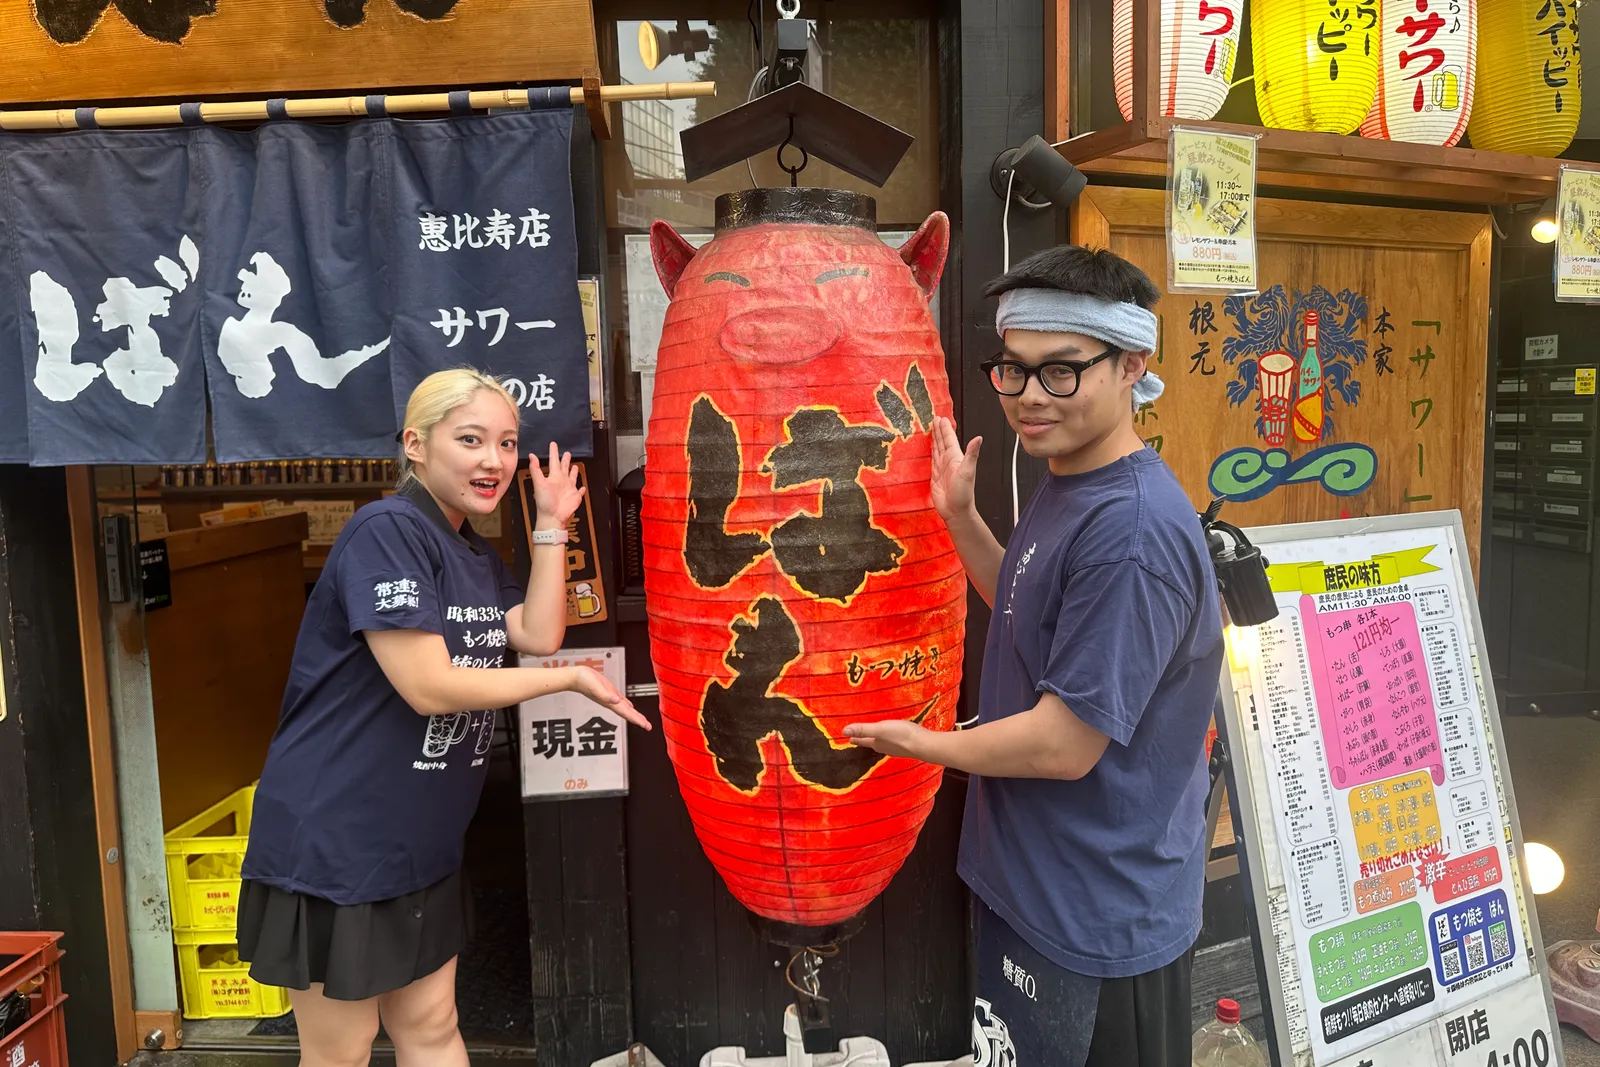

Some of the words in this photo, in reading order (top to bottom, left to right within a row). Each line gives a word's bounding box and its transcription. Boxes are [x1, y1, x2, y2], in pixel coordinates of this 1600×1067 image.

[1317, 0, 1352, 81] ッピー
[1356, 0, 1377, 56] ワー
[1396, 0, 1446, 112] サワー
[1193, 246, 1222, 260] 880円
[430, 306, 556, 347] サワー
[1323, 561, 1381, 591] 庶民の味方
[1326, 620, 1352, 638] もつ串
[1353, 616, 1400, 652] 121円均一
[532, 716, 618, 759] 現金
[564, 778, 588, 790] のみ
[1452, 906, 1484, 931] もつ焼き
[1445, 1008, 1490, 1057] 閉店
